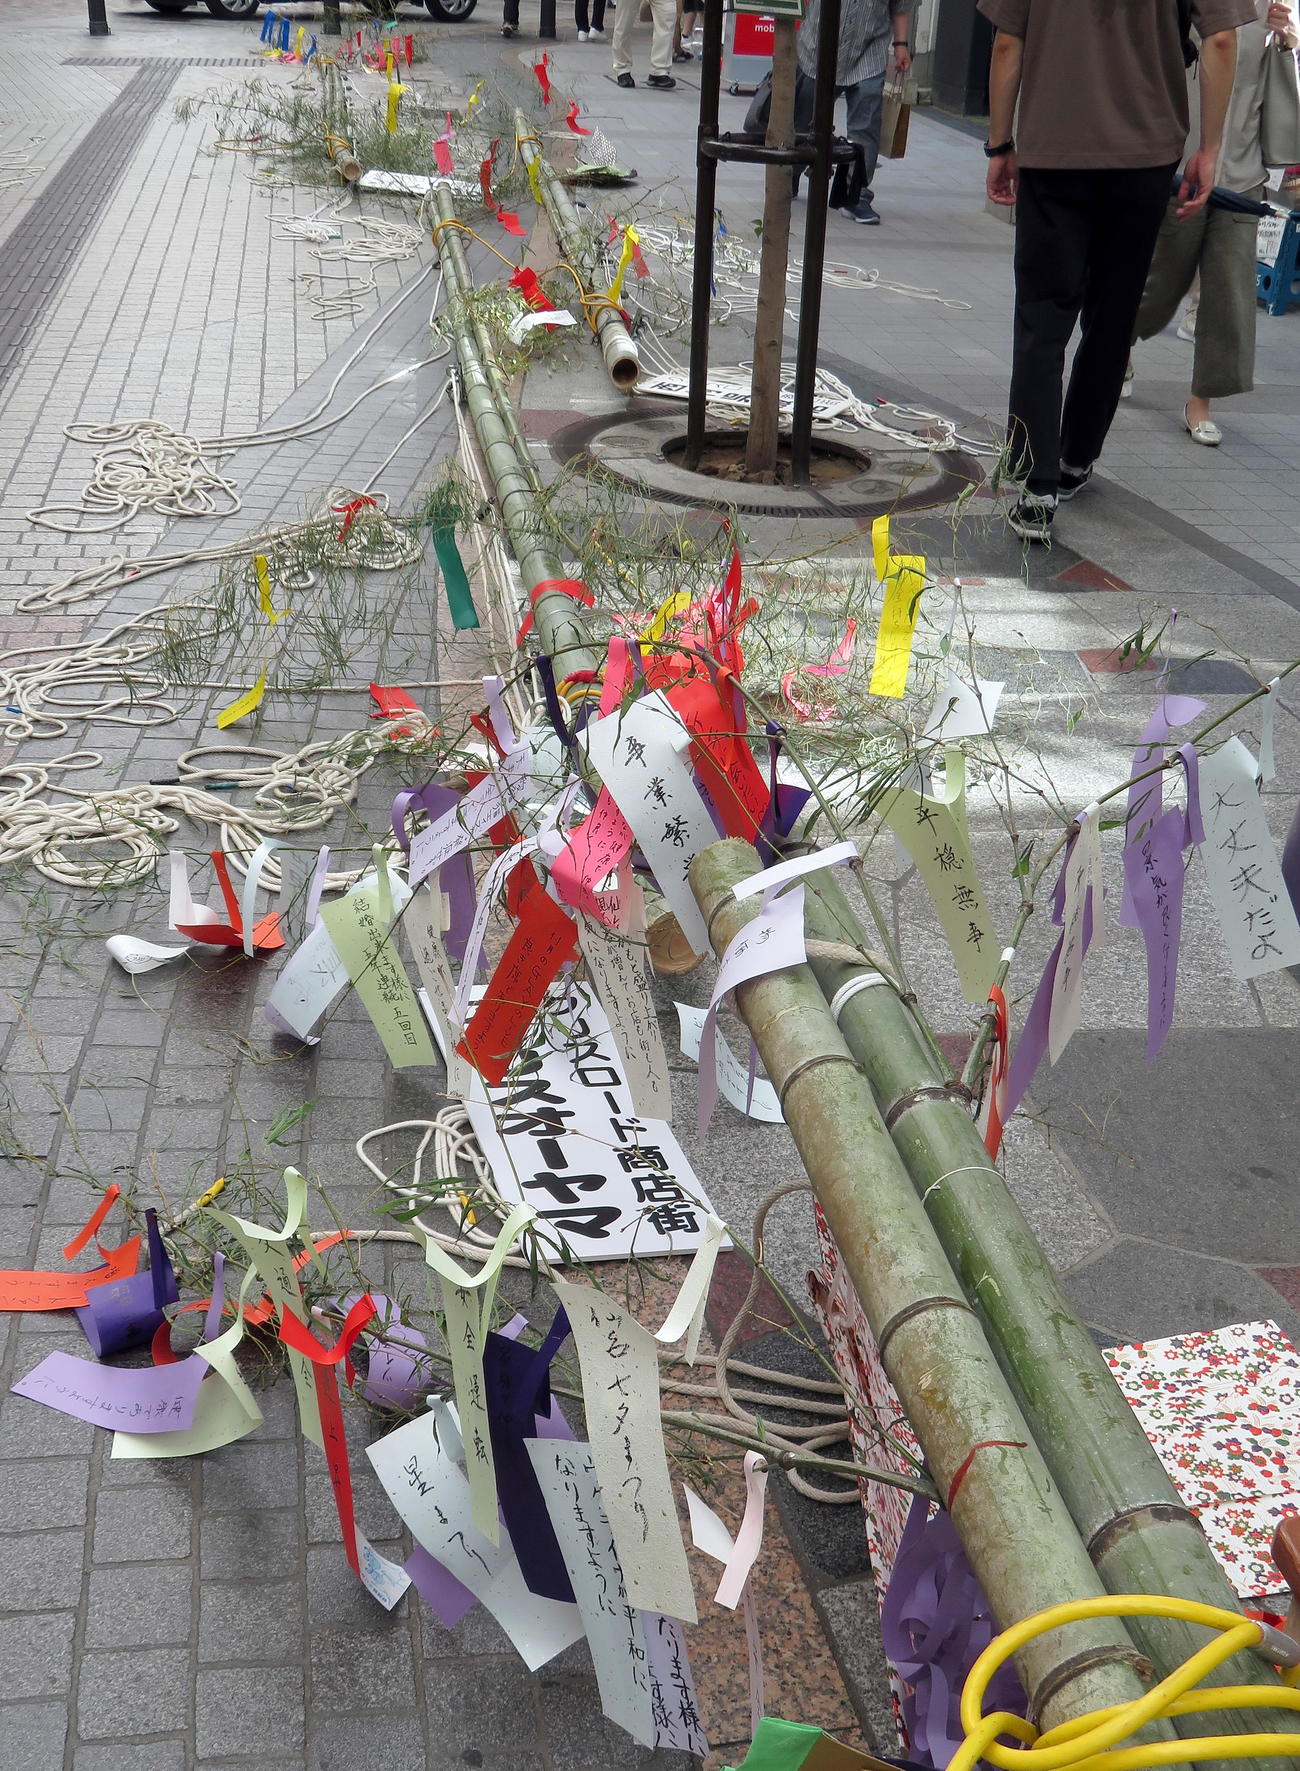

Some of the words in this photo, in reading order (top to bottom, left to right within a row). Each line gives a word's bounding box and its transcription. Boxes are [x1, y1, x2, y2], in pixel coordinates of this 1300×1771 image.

[914, 805, 984, 953] 平穏無事
[556, 1454, 616, 1616] なりますように
